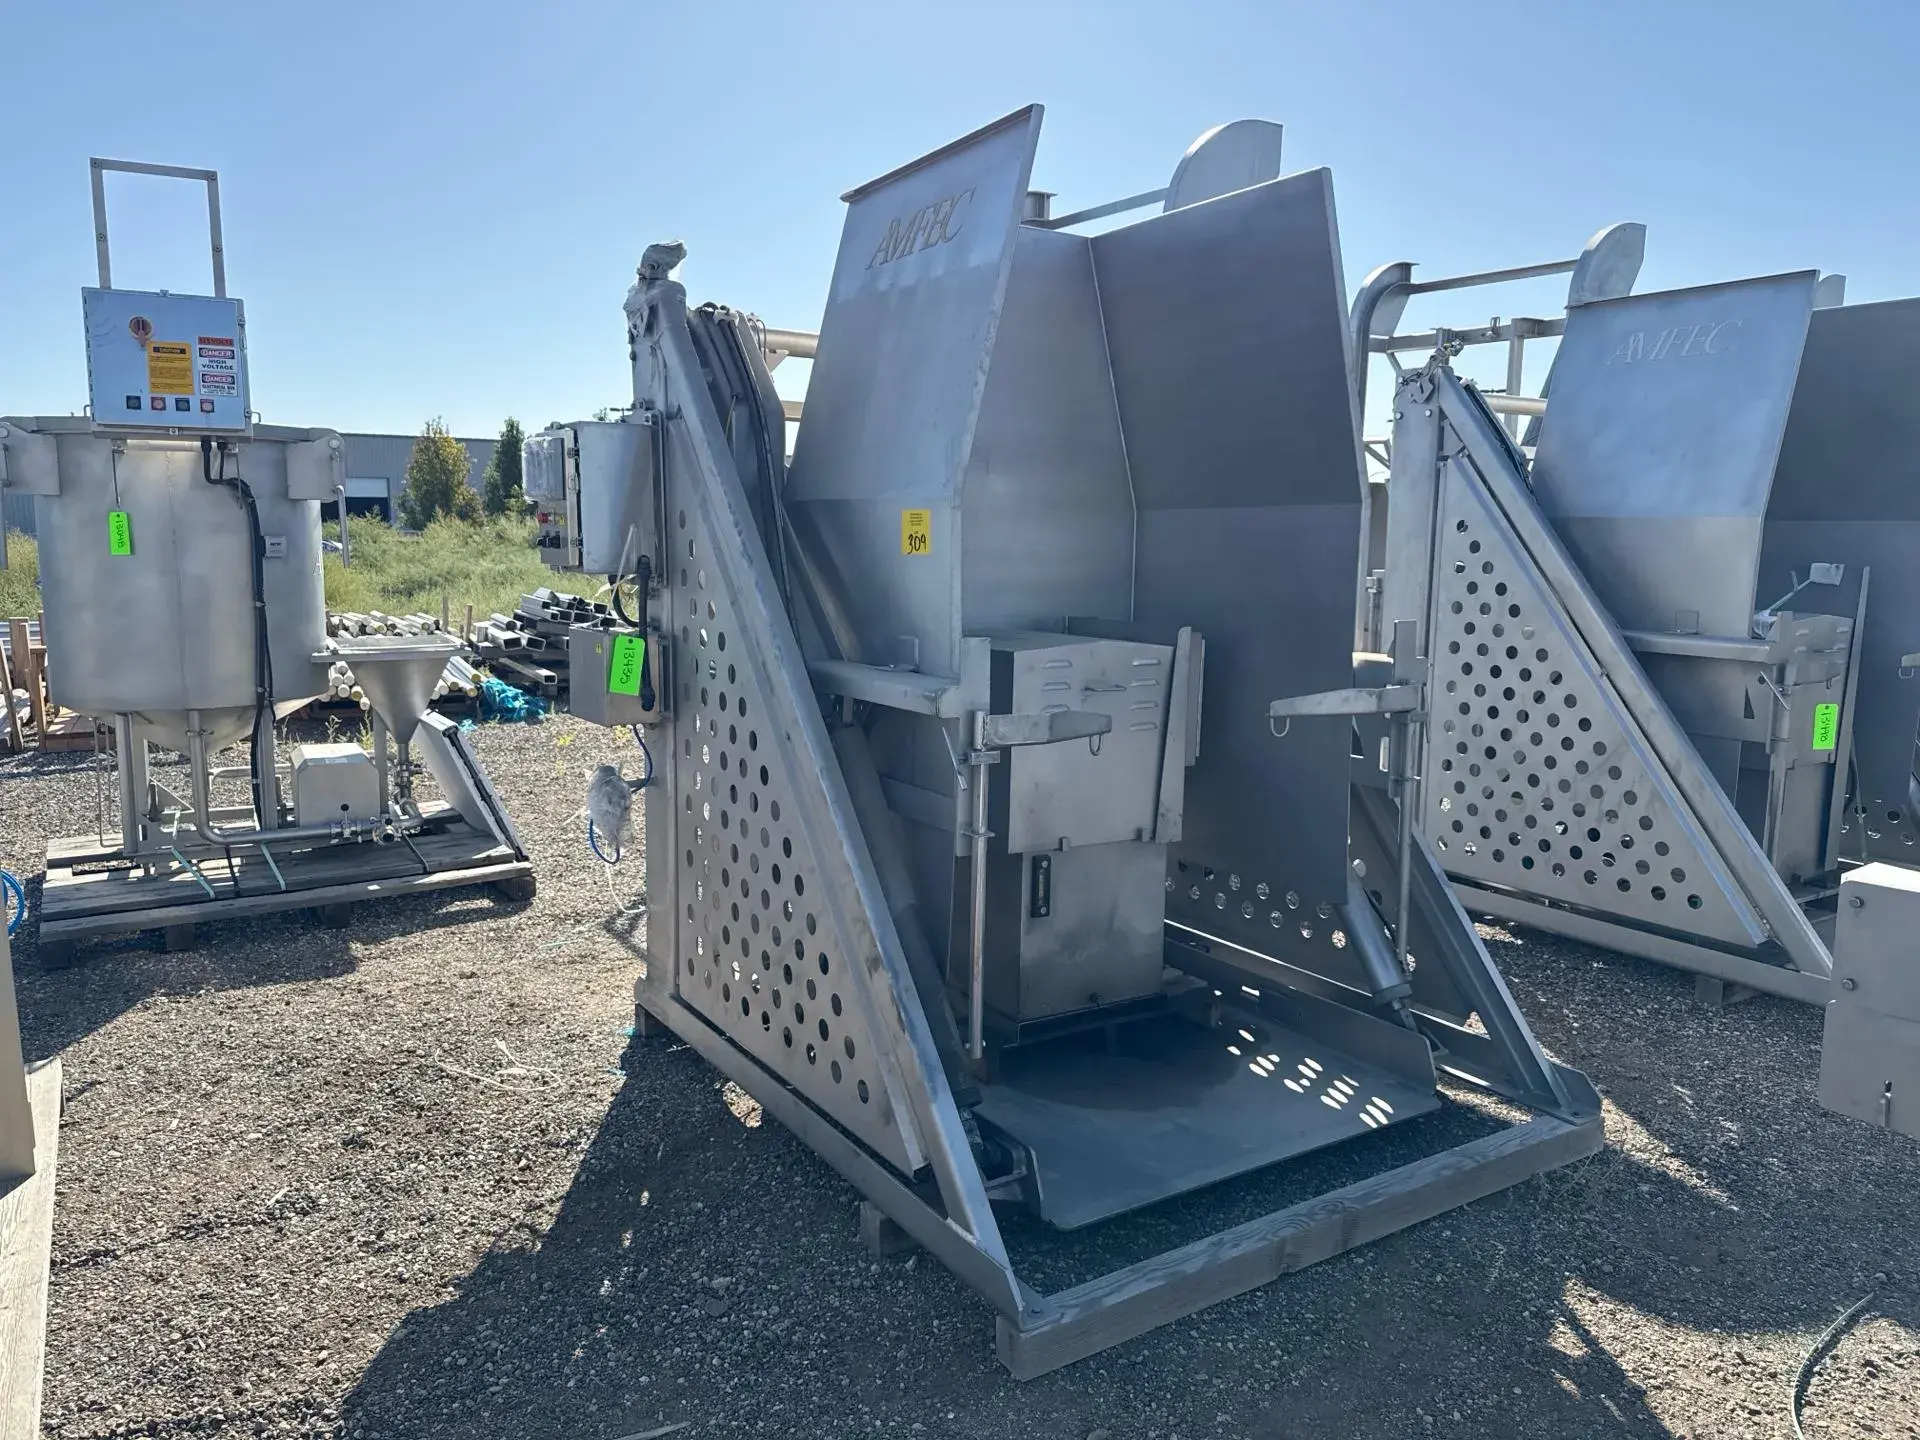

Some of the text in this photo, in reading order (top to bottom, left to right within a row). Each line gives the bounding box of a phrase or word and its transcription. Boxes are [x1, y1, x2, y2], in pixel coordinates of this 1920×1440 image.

[865, 185, 977, 270] AMFEC
[202, 349, 232, 357] DANGER
[1605, 319, 1743, 365] AMFEC
[204, 375, 232, 383] DANGER
[907, 533, 927, 555] 309
[619, 647, 635, 685] 13435
